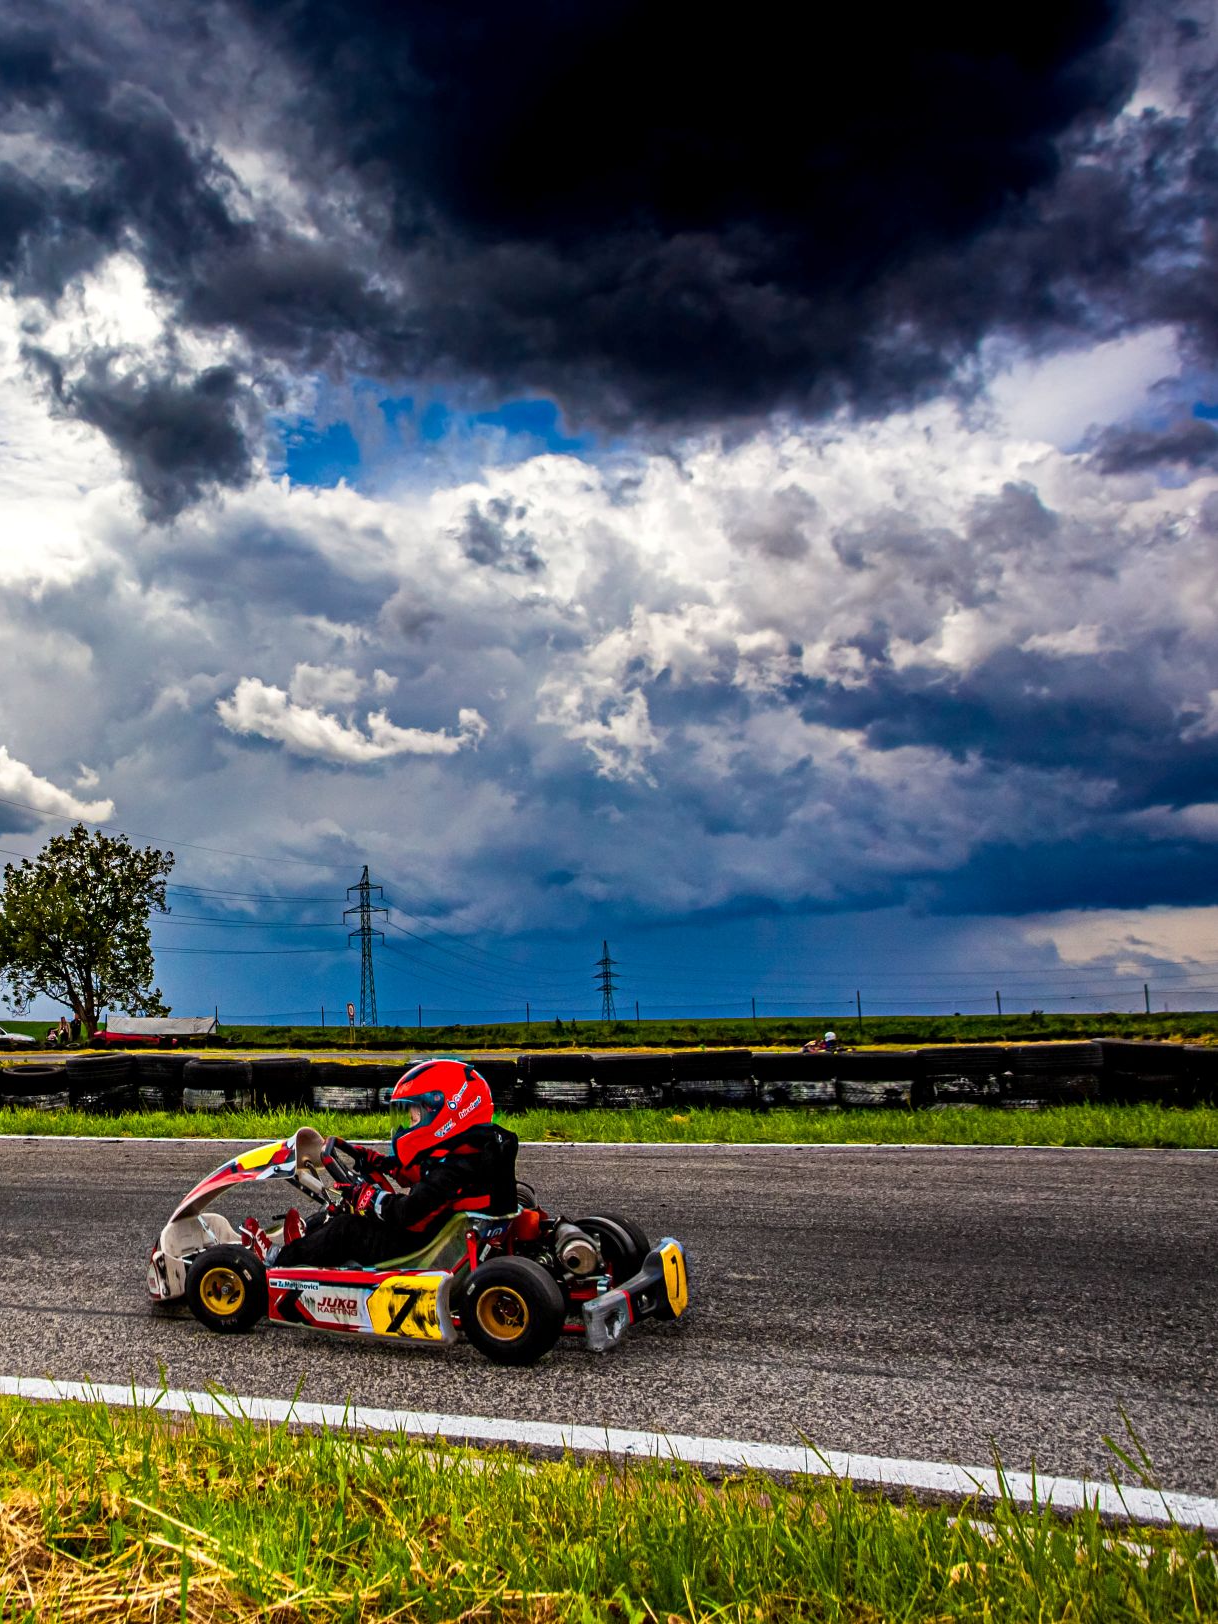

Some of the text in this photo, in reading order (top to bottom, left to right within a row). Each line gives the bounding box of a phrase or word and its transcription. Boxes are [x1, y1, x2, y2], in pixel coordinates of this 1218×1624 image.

[317, 1297, 358, 1309] JUKO
[317, 1306, 358, 1317] KARTING
[386, 1288, 422, 1333] 7
